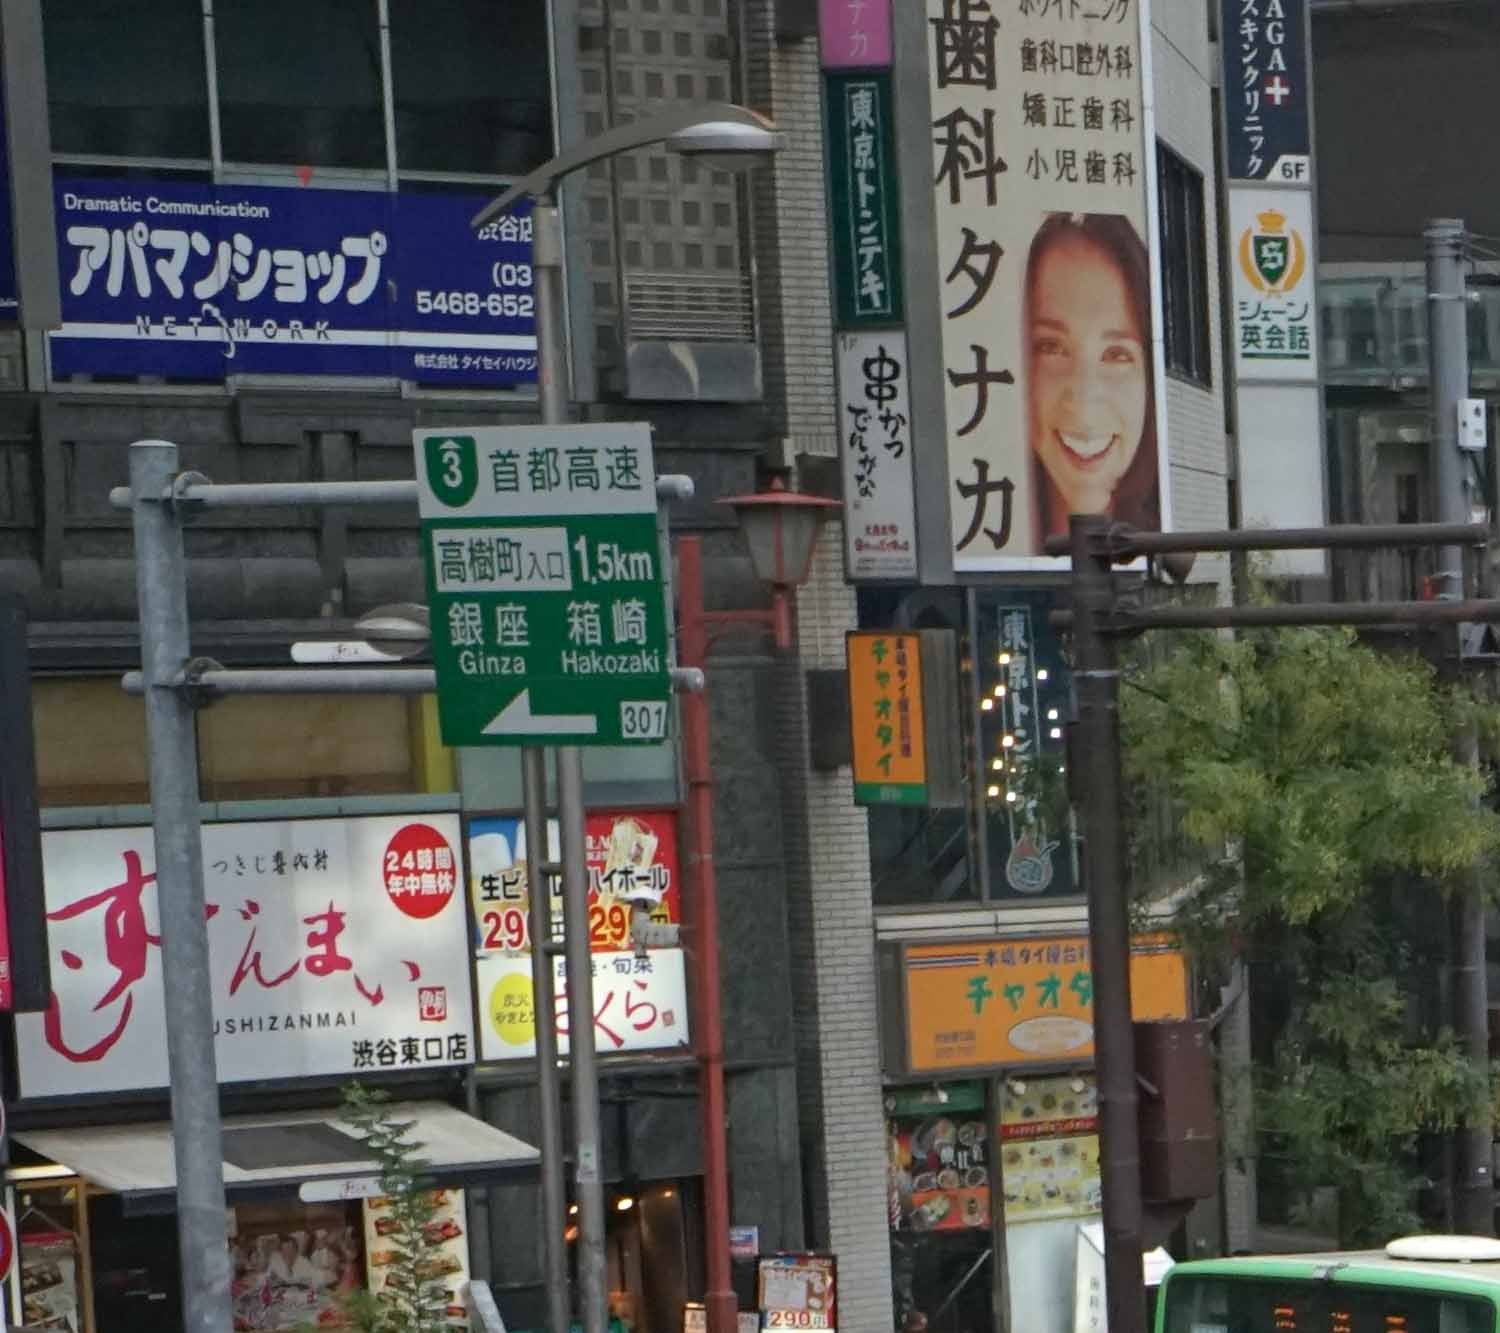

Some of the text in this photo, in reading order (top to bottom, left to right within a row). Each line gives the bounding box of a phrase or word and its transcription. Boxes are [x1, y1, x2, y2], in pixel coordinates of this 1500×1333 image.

[1265, 0, 1287, 71] AGA
[1021, 39, 1133, 78] 歯科口腔外科
[1022, 92, 1136, 132] 矯正歯科
[1025, 149, 1138, 186] 小児歯科
[1281, 161, 1307, 179] 6F
[64, 193, 270, 218] Dramatic Communication
[850, 88, 885, 309] 東京トンテキ
[67, 222, 388, 305] アパマンショップ
[492, 262, 534, 287] (03
[928, 0, 1015, 553] 歯科タナカ
[416, 292, 535, 318] 5468-652
[1239, 301, 1309, 322] シェーン
[1241, 325, 1310, 350] 英会話
[462, 355, 537, 373] タイセイ・ハウジ
[441, 450, 464, 488] 3
[489, 445, 642, 493] 首都高速
[437, 536, 565, 583] 高樹町入口
[574, 535, 654, 585] 1.5km
[448, 602, 530, 647] 銀座
[567, 599, 648, 647] 箱崎
[458, 650, 527, 675] Ginza
[561, 648, 660, 674] Hakozaki
[624, 706, 664, 735] 301
[386, 847, 452, 872] 24時間
[388, 872, 457, 896] 年中無休
[965, 969, 1094, 1016] チャオタ
[211, 1009, 357, 1037] USHIZANMAI
[351, 1033, 468, 1068] 渋谷東口店
